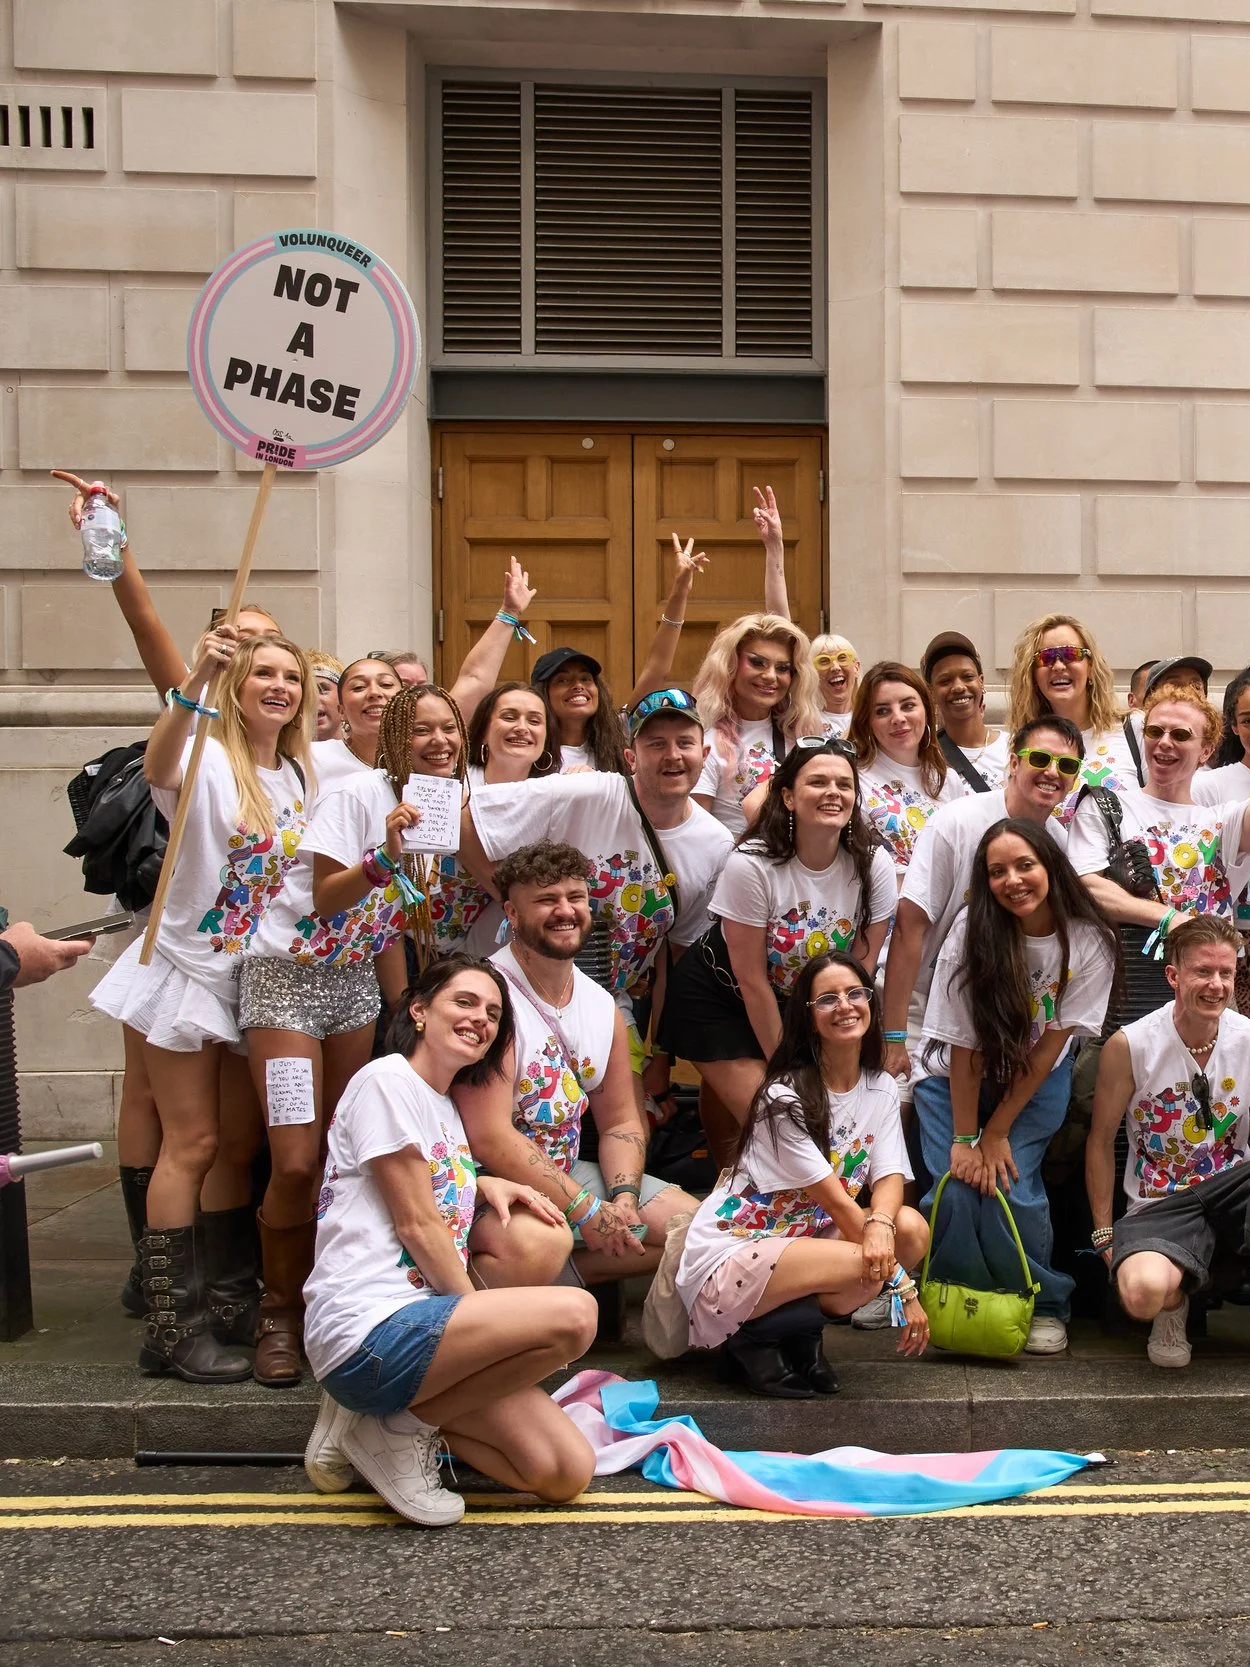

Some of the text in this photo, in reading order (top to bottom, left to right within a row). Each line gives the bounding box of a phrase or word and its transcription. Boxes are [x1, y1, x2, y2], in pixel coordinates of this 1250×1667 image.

[279, 233, 372, 268] VOLUNQUEER
[273, 264, 360, 314] NOT
[286, 321, 315, 358] A
[223, 357, 361, 421] PHASE
[255, 452, 294, 468] IN LONDON
[257, 440, 296, 460] PRIDE
[885, 815, 909, 838] AS
[245, 855, 278, 876] AS
[1148, 835, 1219, 869] JOY
[1185, 866, 1216, 886] AN
[589, 871, 671, 918] JOY
[295, 915, 364, 966] RESIST
[773, 927, 855, 958] JOY
[534, 1101, 565, 1124] AS
[1149, 1104, 1238, 1144] JOY
[1149, 1134, 1180, 1155] AS
